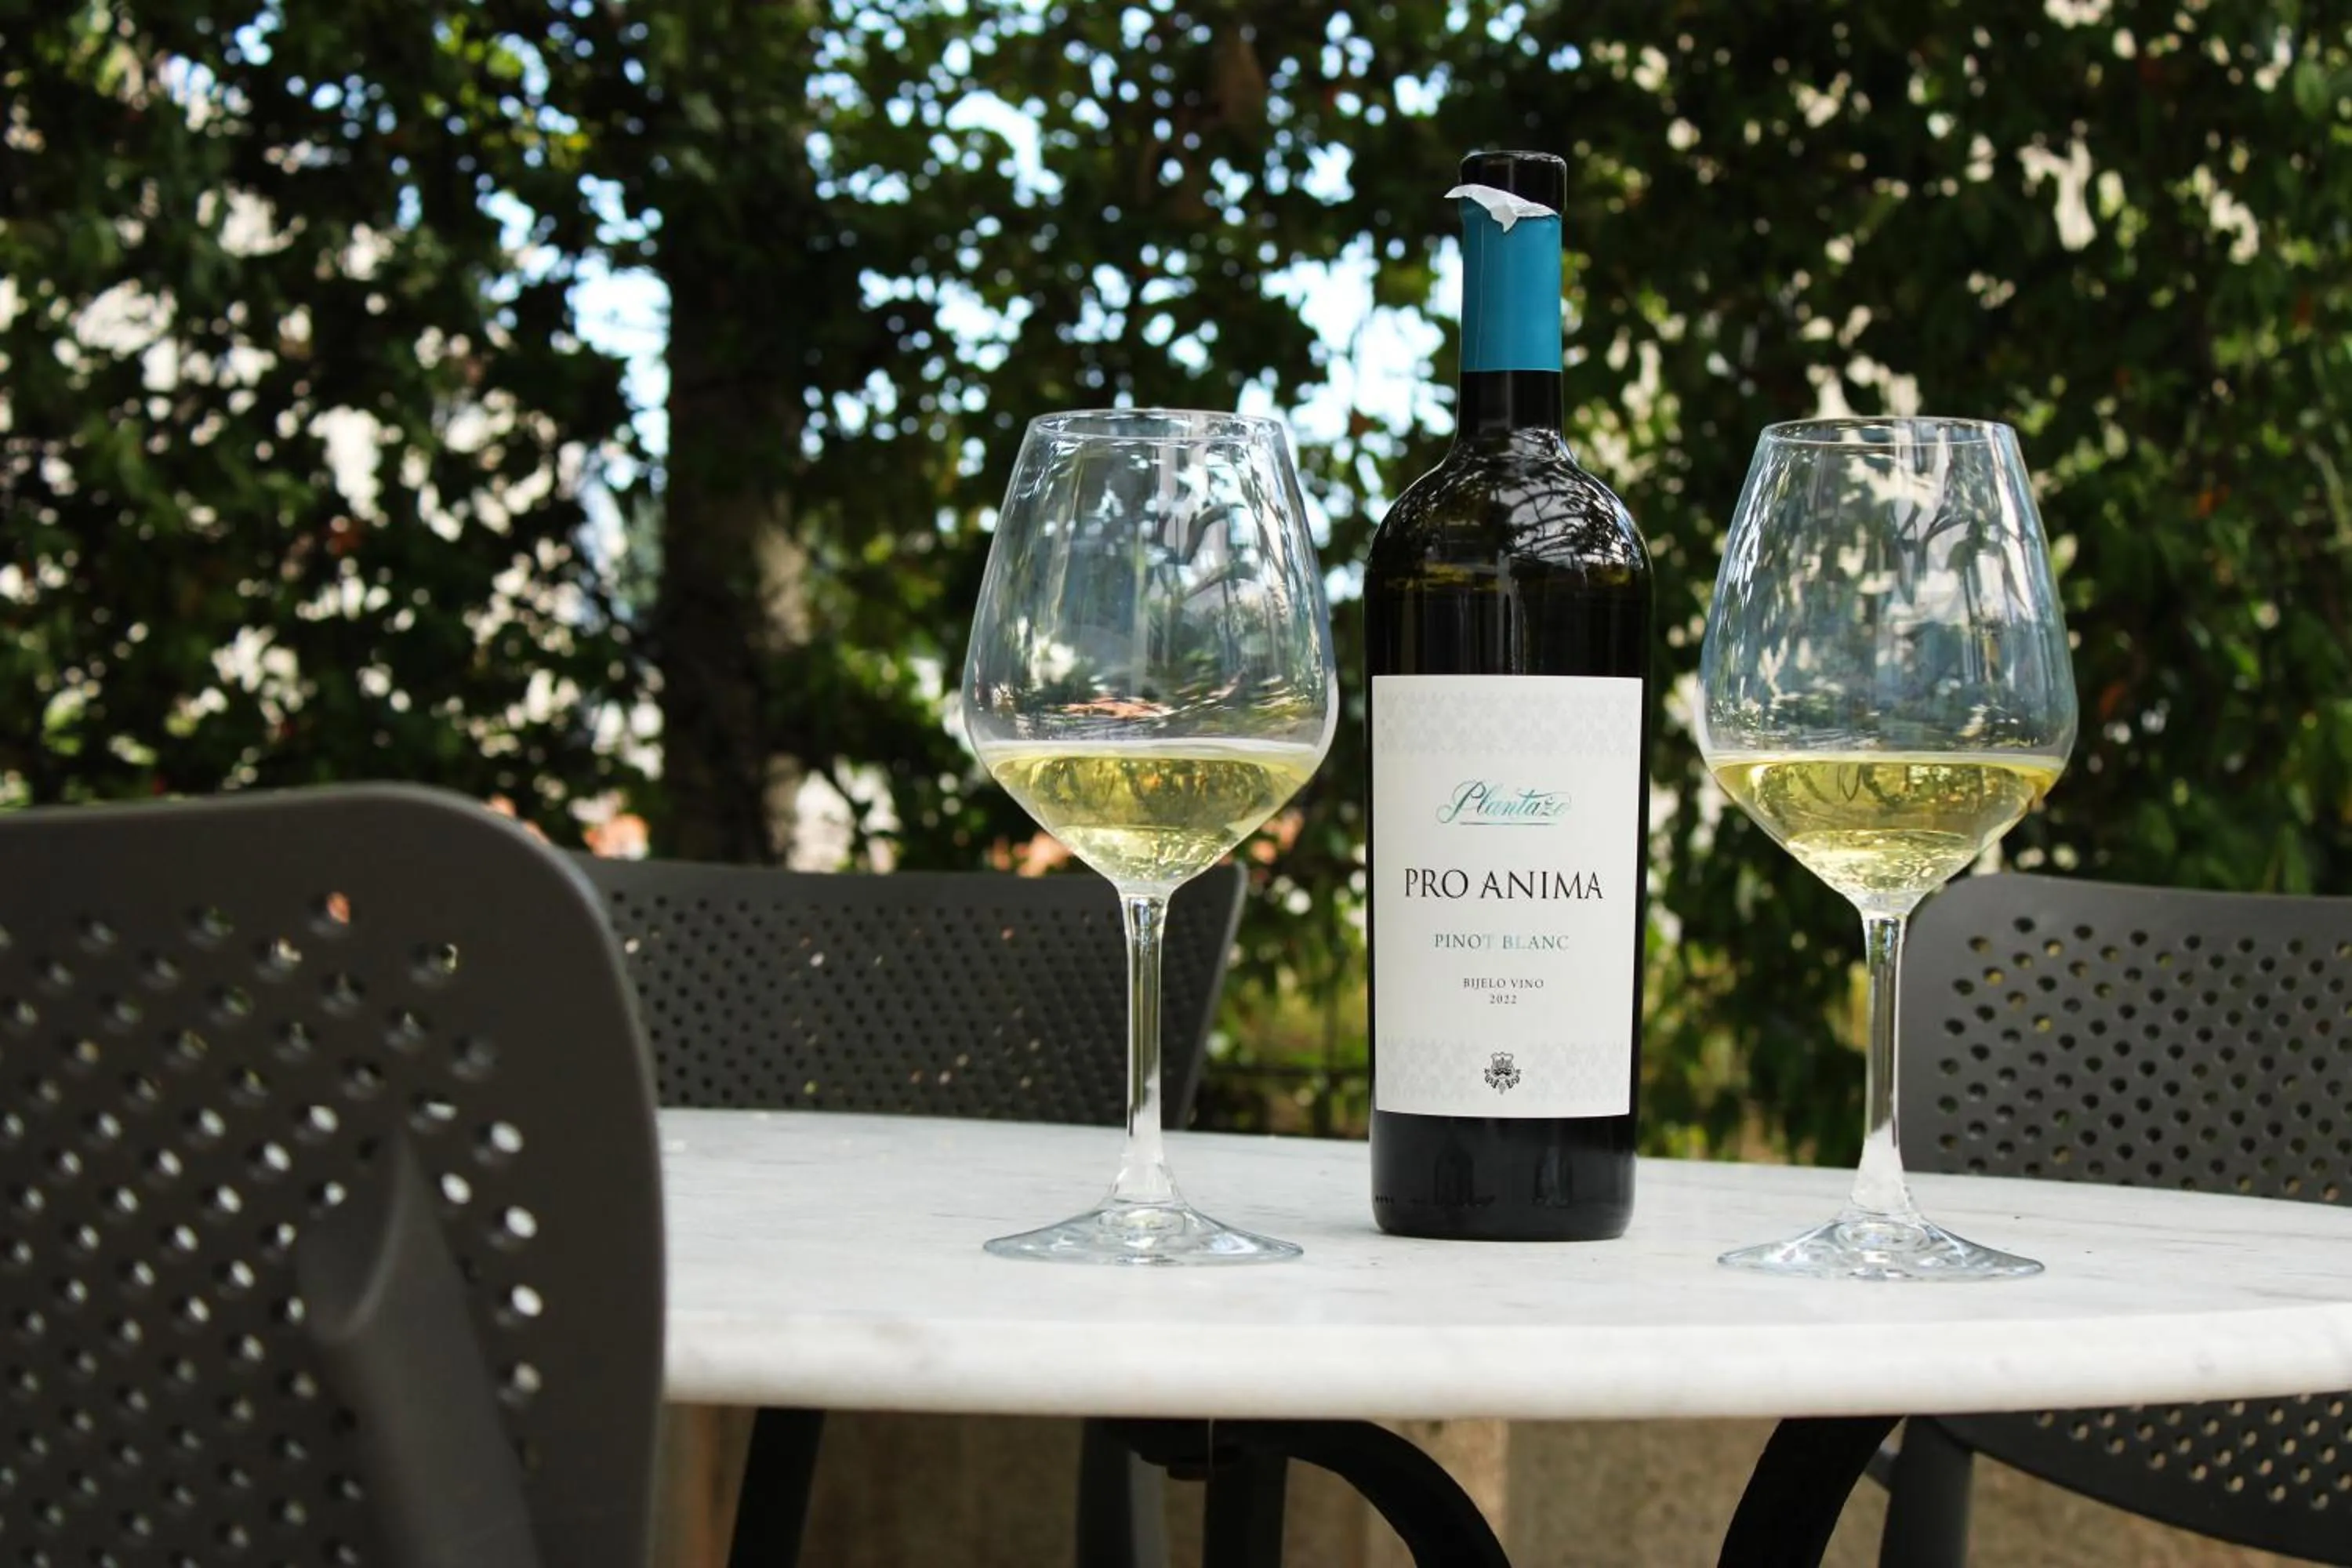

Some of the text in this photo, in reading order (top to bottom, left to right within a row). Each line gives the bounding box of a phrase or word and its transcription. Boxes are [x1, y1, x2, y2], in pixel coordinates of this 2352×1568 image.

[1404, 867, 1603, 899] PRO ANIMA
[1434, 933, 1570, 950] PINOT BLANC
[1463, 978, 1544, 989] BIJELO VINO
[1489, 993, 1517, 1005] 2022
